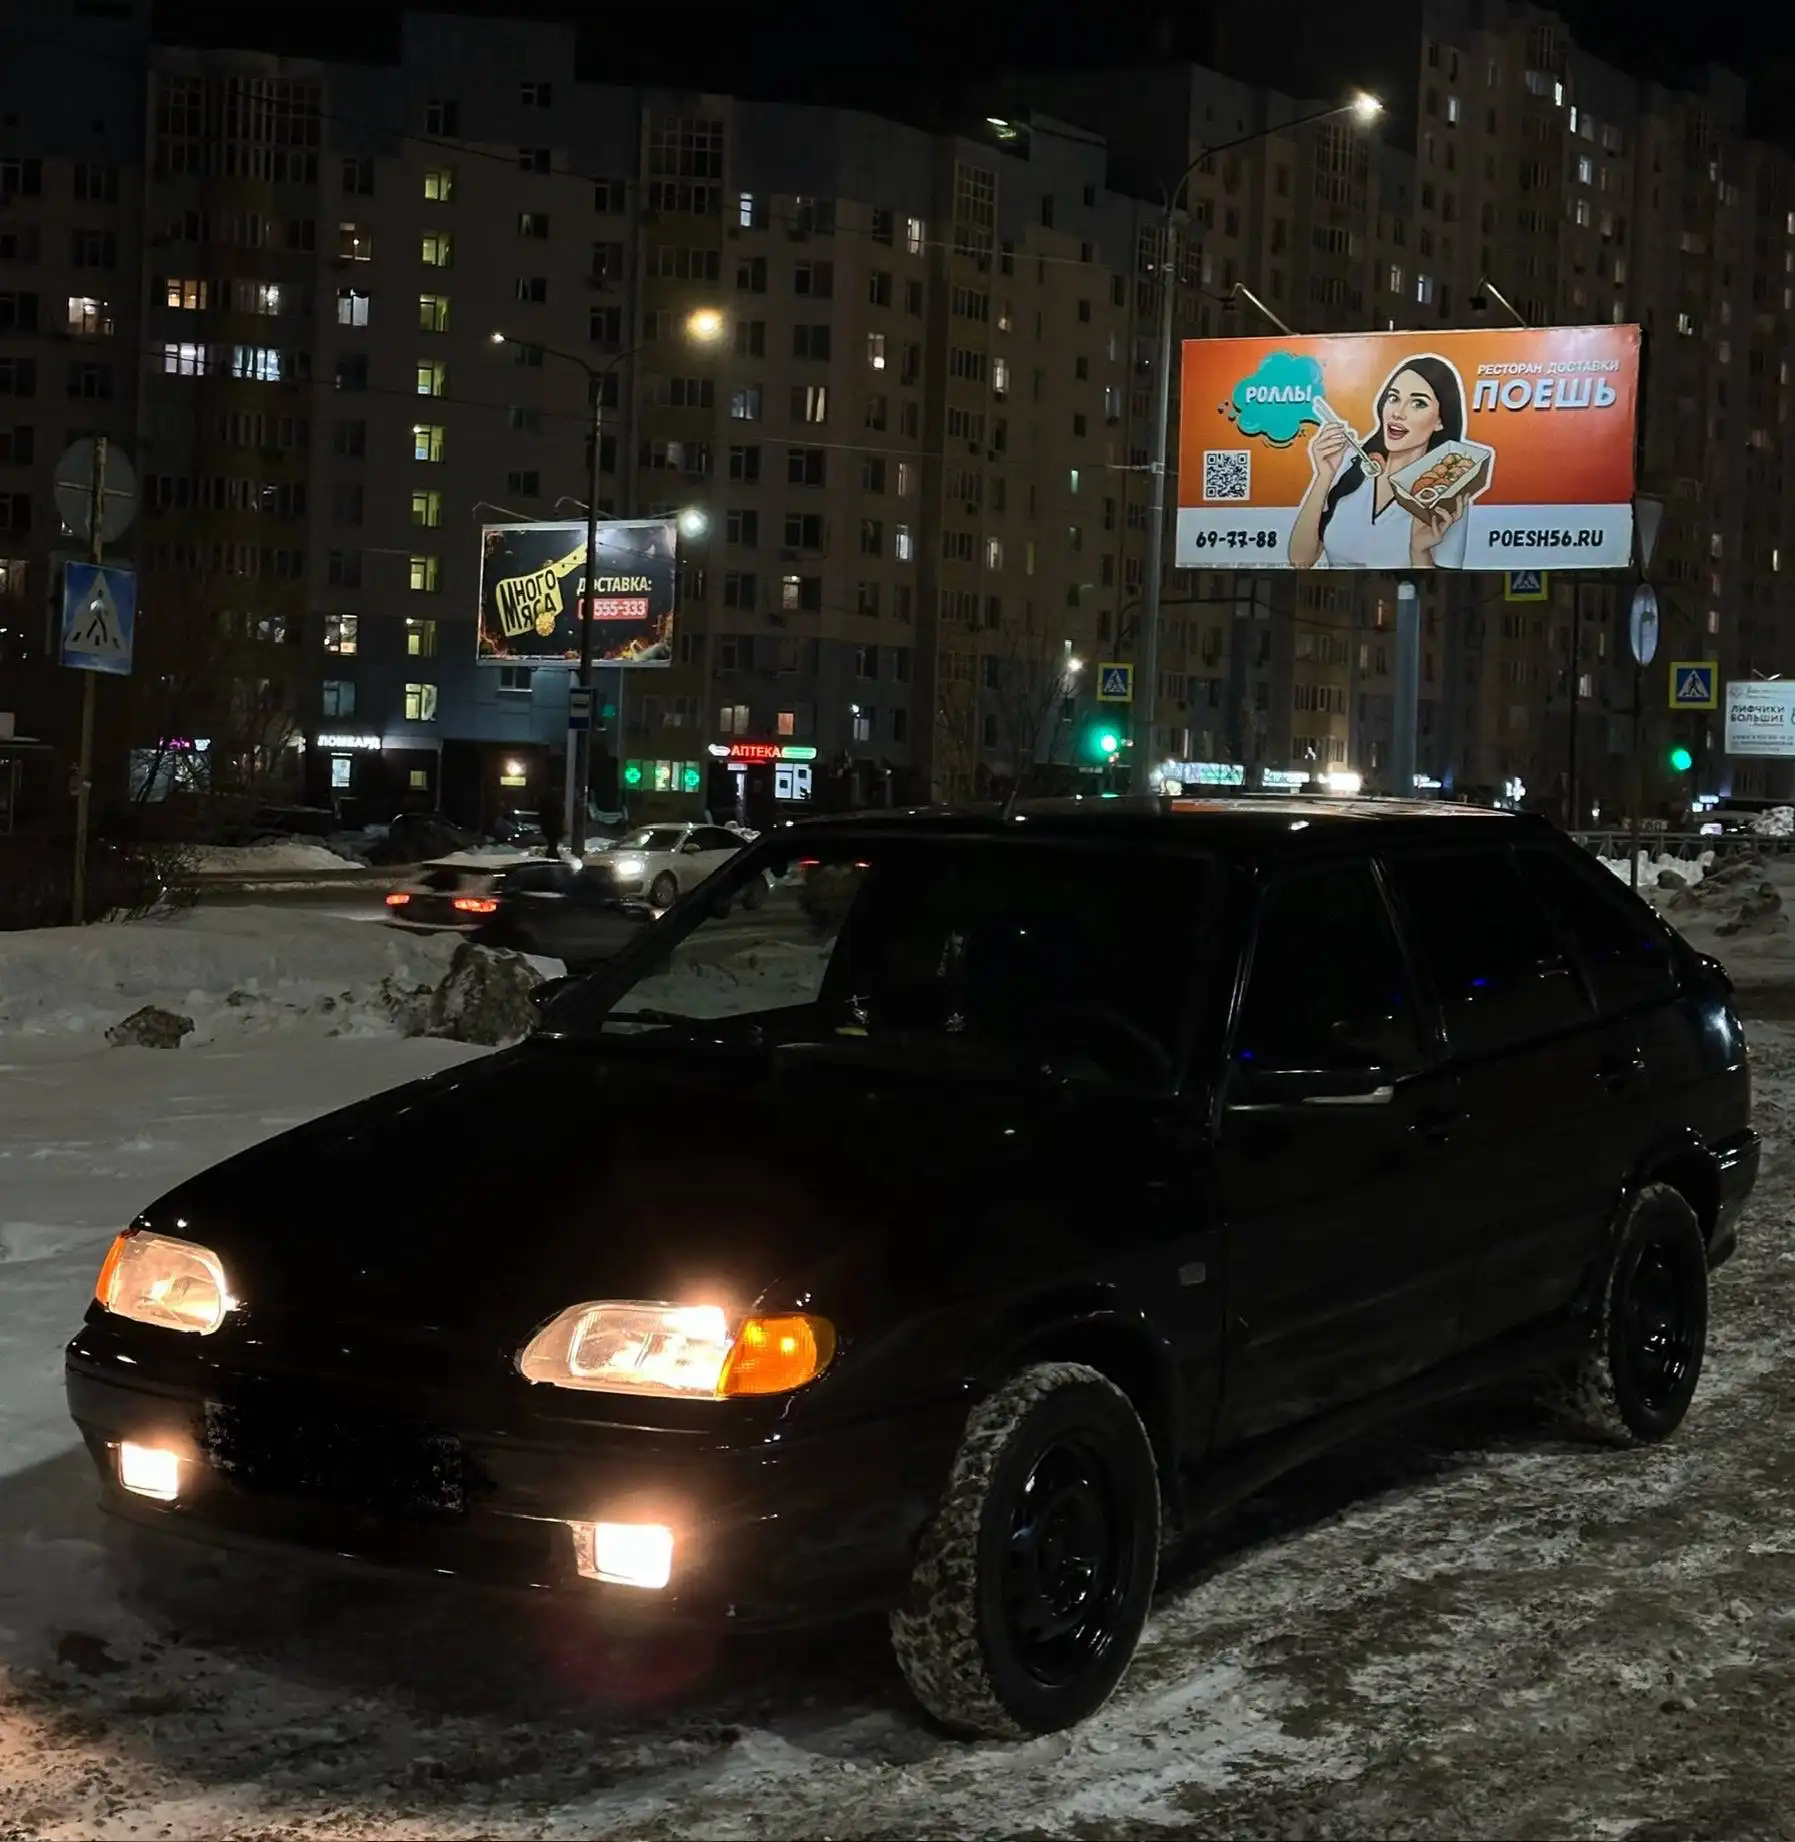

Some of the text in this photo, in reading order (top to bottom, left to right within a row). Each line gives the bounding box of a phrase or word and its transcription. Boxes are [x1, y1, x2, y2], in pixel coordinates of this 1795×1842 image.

[1477, 359, 1620, 375] РЕСТОРАН ДОСТАВКИ
[1245, 384, 1313, 404] РОЛЛЫ
[1472, 377, 1617, 412] ПОЕШЬ
[1195, 530, 1278, 548] 69-77-88
[1488, 529, 1604, 547] POESH56.RU
[500, 569, 556, 632] МНОГО
[1730, 704, 1785, 713] ЛИФЧИКИ
[730, 743, 781, 758] АПТЕКА
